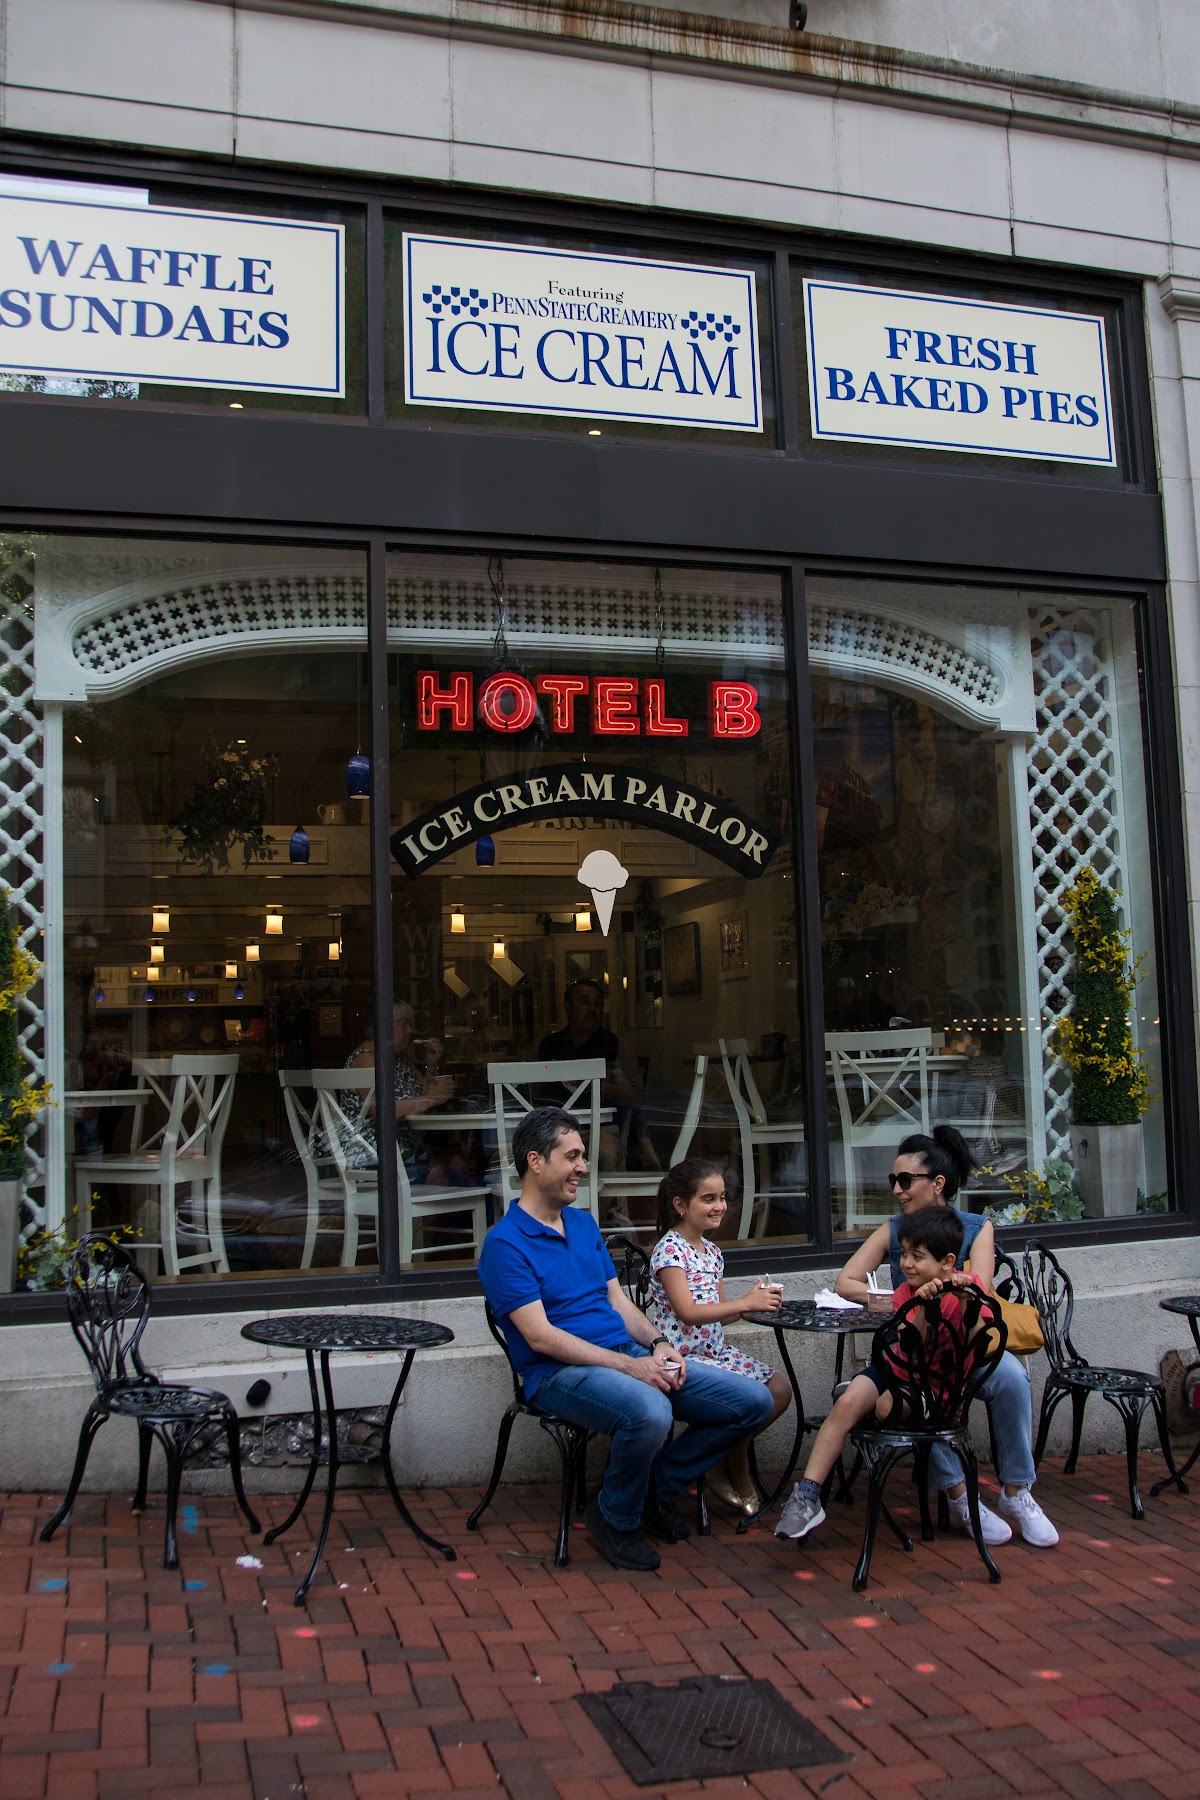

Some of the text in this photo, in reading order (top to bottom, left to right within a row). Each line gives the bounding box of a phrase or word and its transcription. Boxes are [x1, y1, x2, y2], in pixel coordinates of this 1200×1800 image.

[17, 236, 275, 296] WAFFLE
[548, 280, 625, 305] Featuring
[0, 290, 290, 349] SUNDAES
[426, 317, 742, 399] ICE CREAM
[884, 326, 1039, 376] FRESH
[824, 366, 1100, 428] BAKED PIES
[416, 670, 689, 737] HOTEL
[708, 681, 762, 738] B
[401, 806, 473, 865] ICE
[473, 773, 616, 822] CREAM
[623, 776, 770, 865] PARLOR
[172, 987, 215, 1001] FSH
